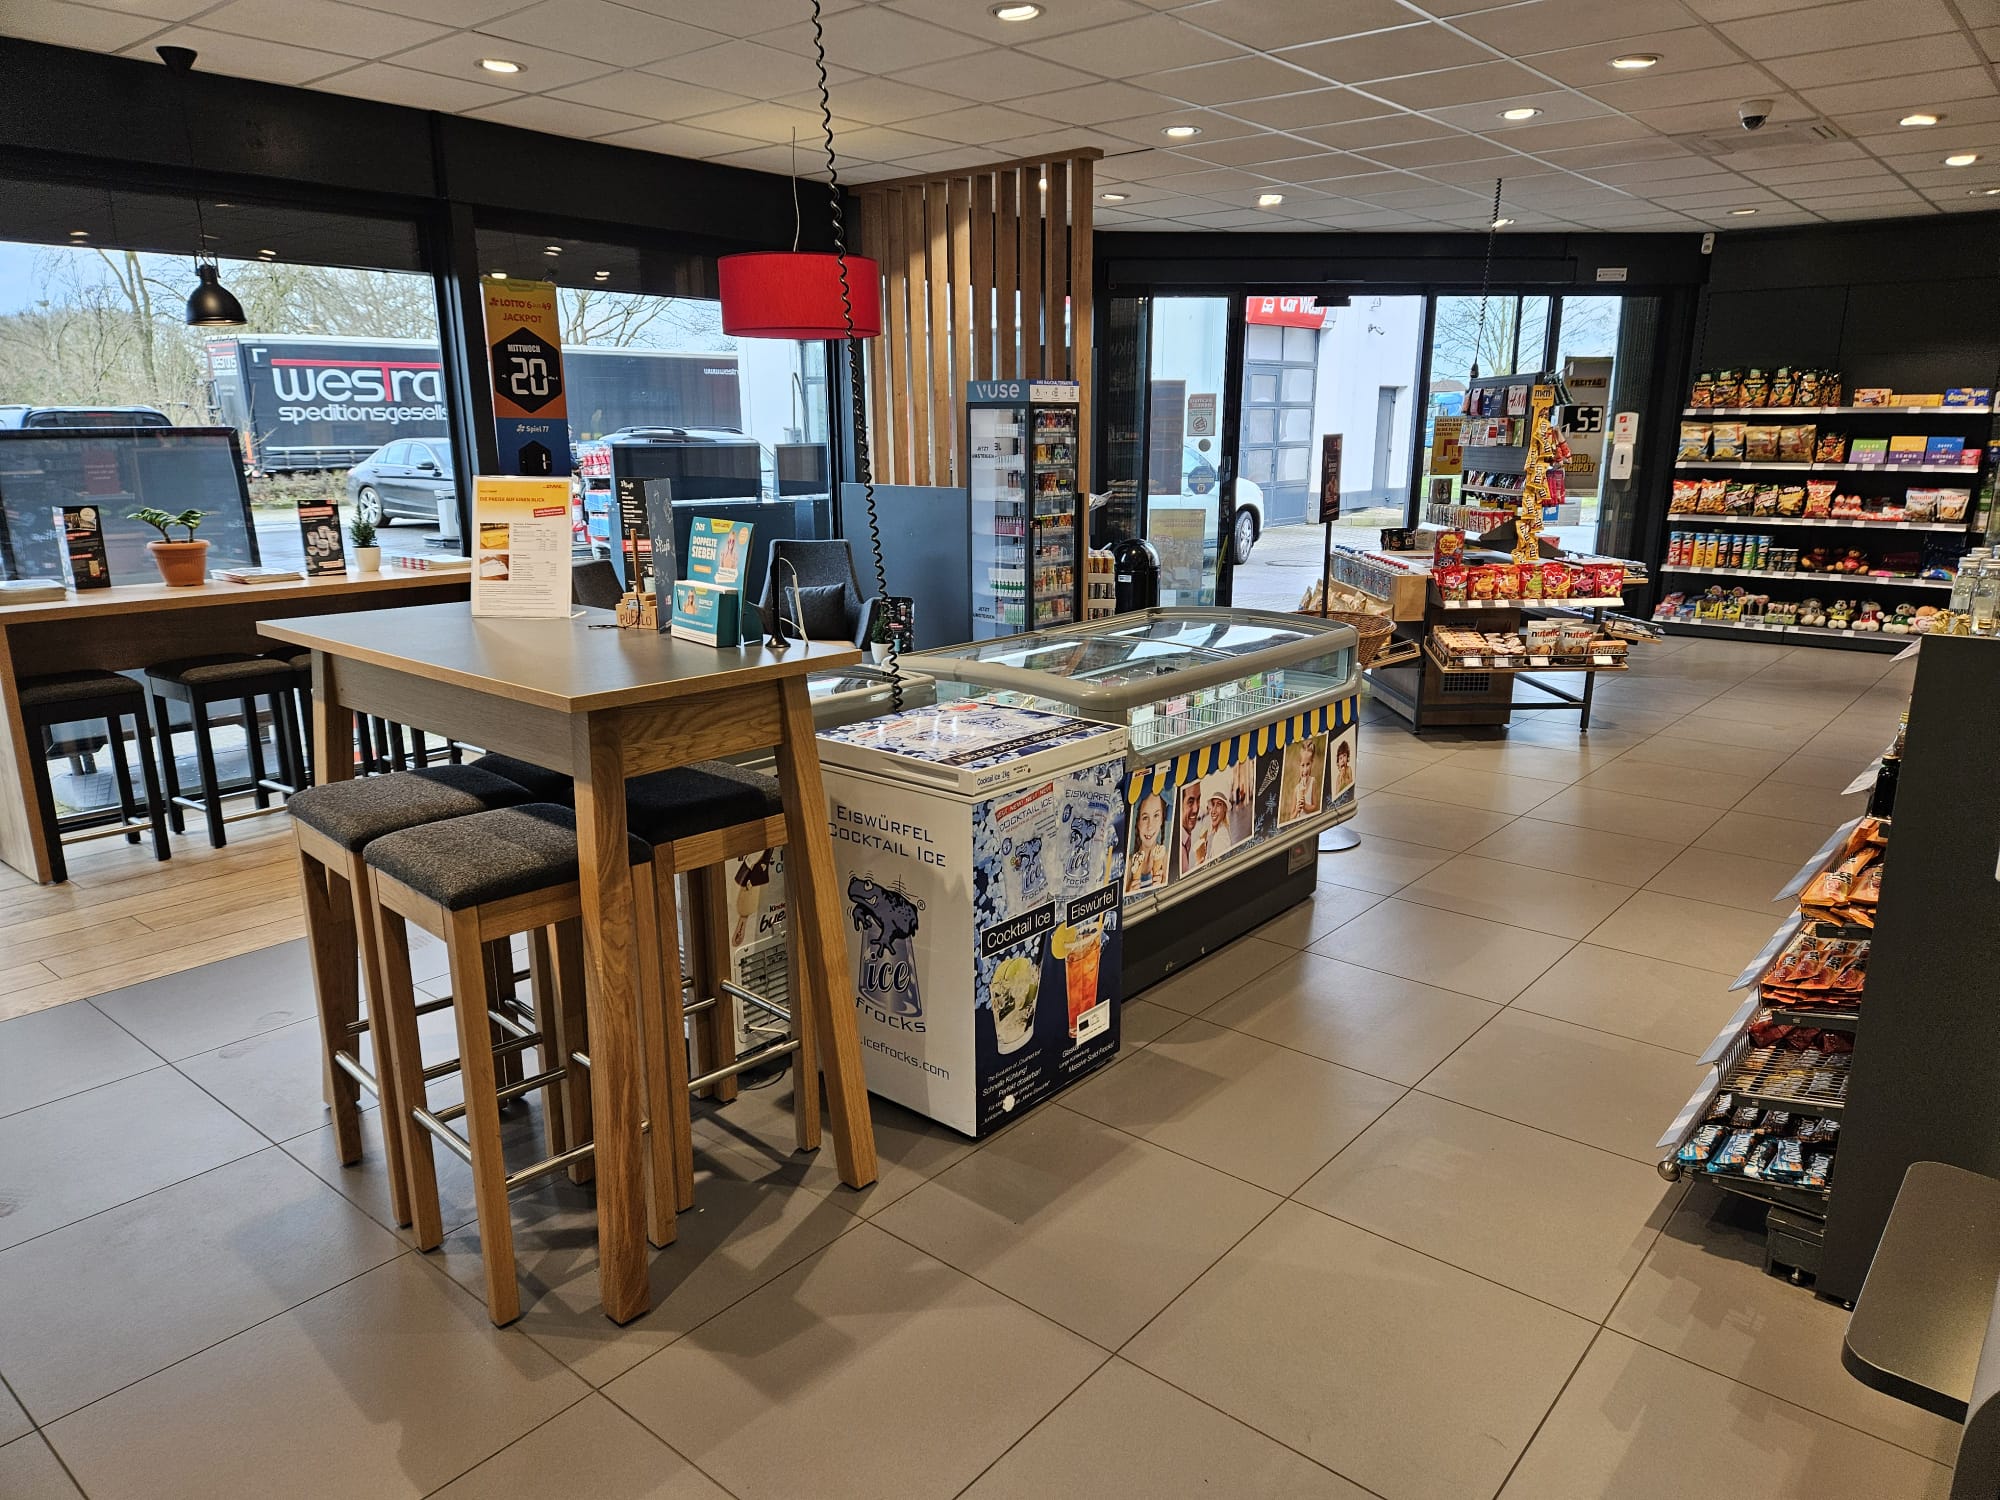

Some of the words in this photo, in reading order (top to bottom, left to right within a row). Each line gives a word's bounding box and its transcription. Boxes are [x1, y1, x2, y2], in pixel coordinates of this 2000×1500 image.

[500, 299, 525, 308] LOTTO
[503, 313, 542, 323] JACKPOT
[507, 344, 541, 353] MITTWOCH
[510, 357, 549, 395] 20
[526, 425, 541, 433] Spiel
[1577, 407, 1602, 431] 53
[691, 545, 717, 560] SIEBEN
[692, 535, 718, 548] DOPPELTE
[837, 805, 934, 843] EISWÜRFEL
[1000, 806, 1039, 833] COCKTAIL
[828, 822, 909, 857] COCKTAIL
[917, 846, 946, 867] ICE
[1071, 889, 1114, 920] Eiswürfel
[986, 916, 1032, 949] Cocktail
[1035, 912, 1051, 928] Ice
[866, 952, 911, 993] ice
[856, 997, 926, 1033] frocks
